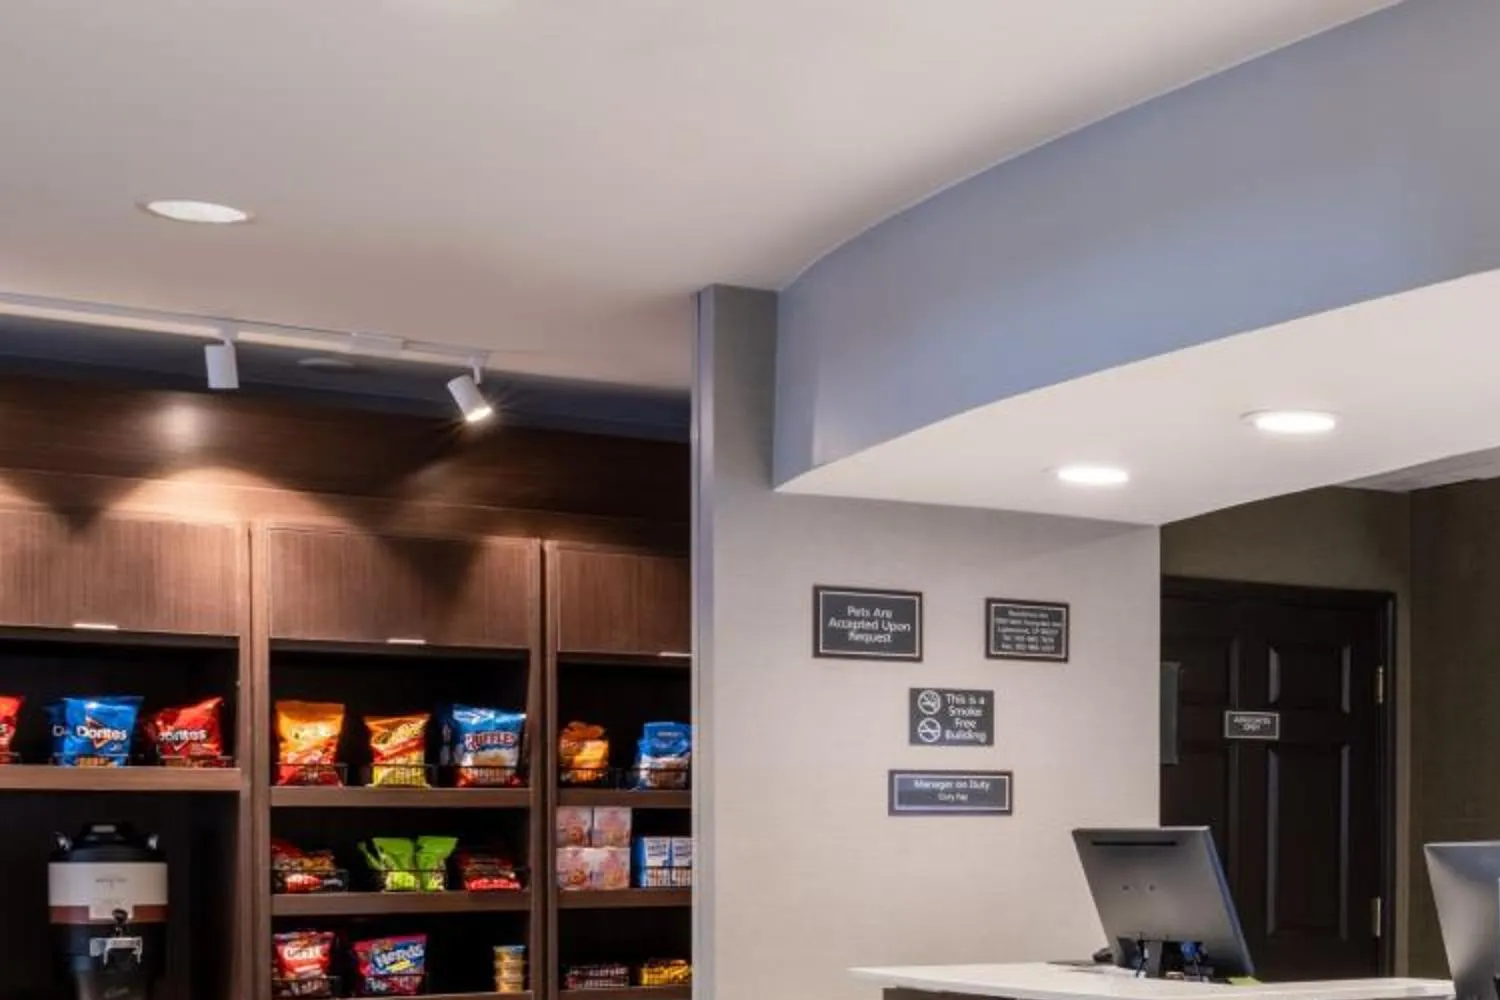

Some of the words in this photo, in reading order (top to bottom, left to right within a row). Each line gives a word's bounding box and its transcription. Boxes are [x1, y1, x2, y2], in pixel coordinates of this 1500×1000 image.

[847, 605, 870, 616] Pets
[873, 607, 893, 618] Are
[828, 617, 879, 631] Accepted
[881, 620, 911, 632] Upon
[848, 631, 892, 644] Request
[945, 693, 966, 705] This
[968, 694, 977, 705] is
[948, 705, 982, 716] Smoke
[955, 718, 977, 728] Free
[76, 725, 128, 741] Doritos
[945, 730, 987, 743] Building
[464, 731, 517, 750] RUFFLES
[914, 780, 953, 790] Manager
[956, 781, 969, 789] on
[970, 780, 990, 791] Duty
